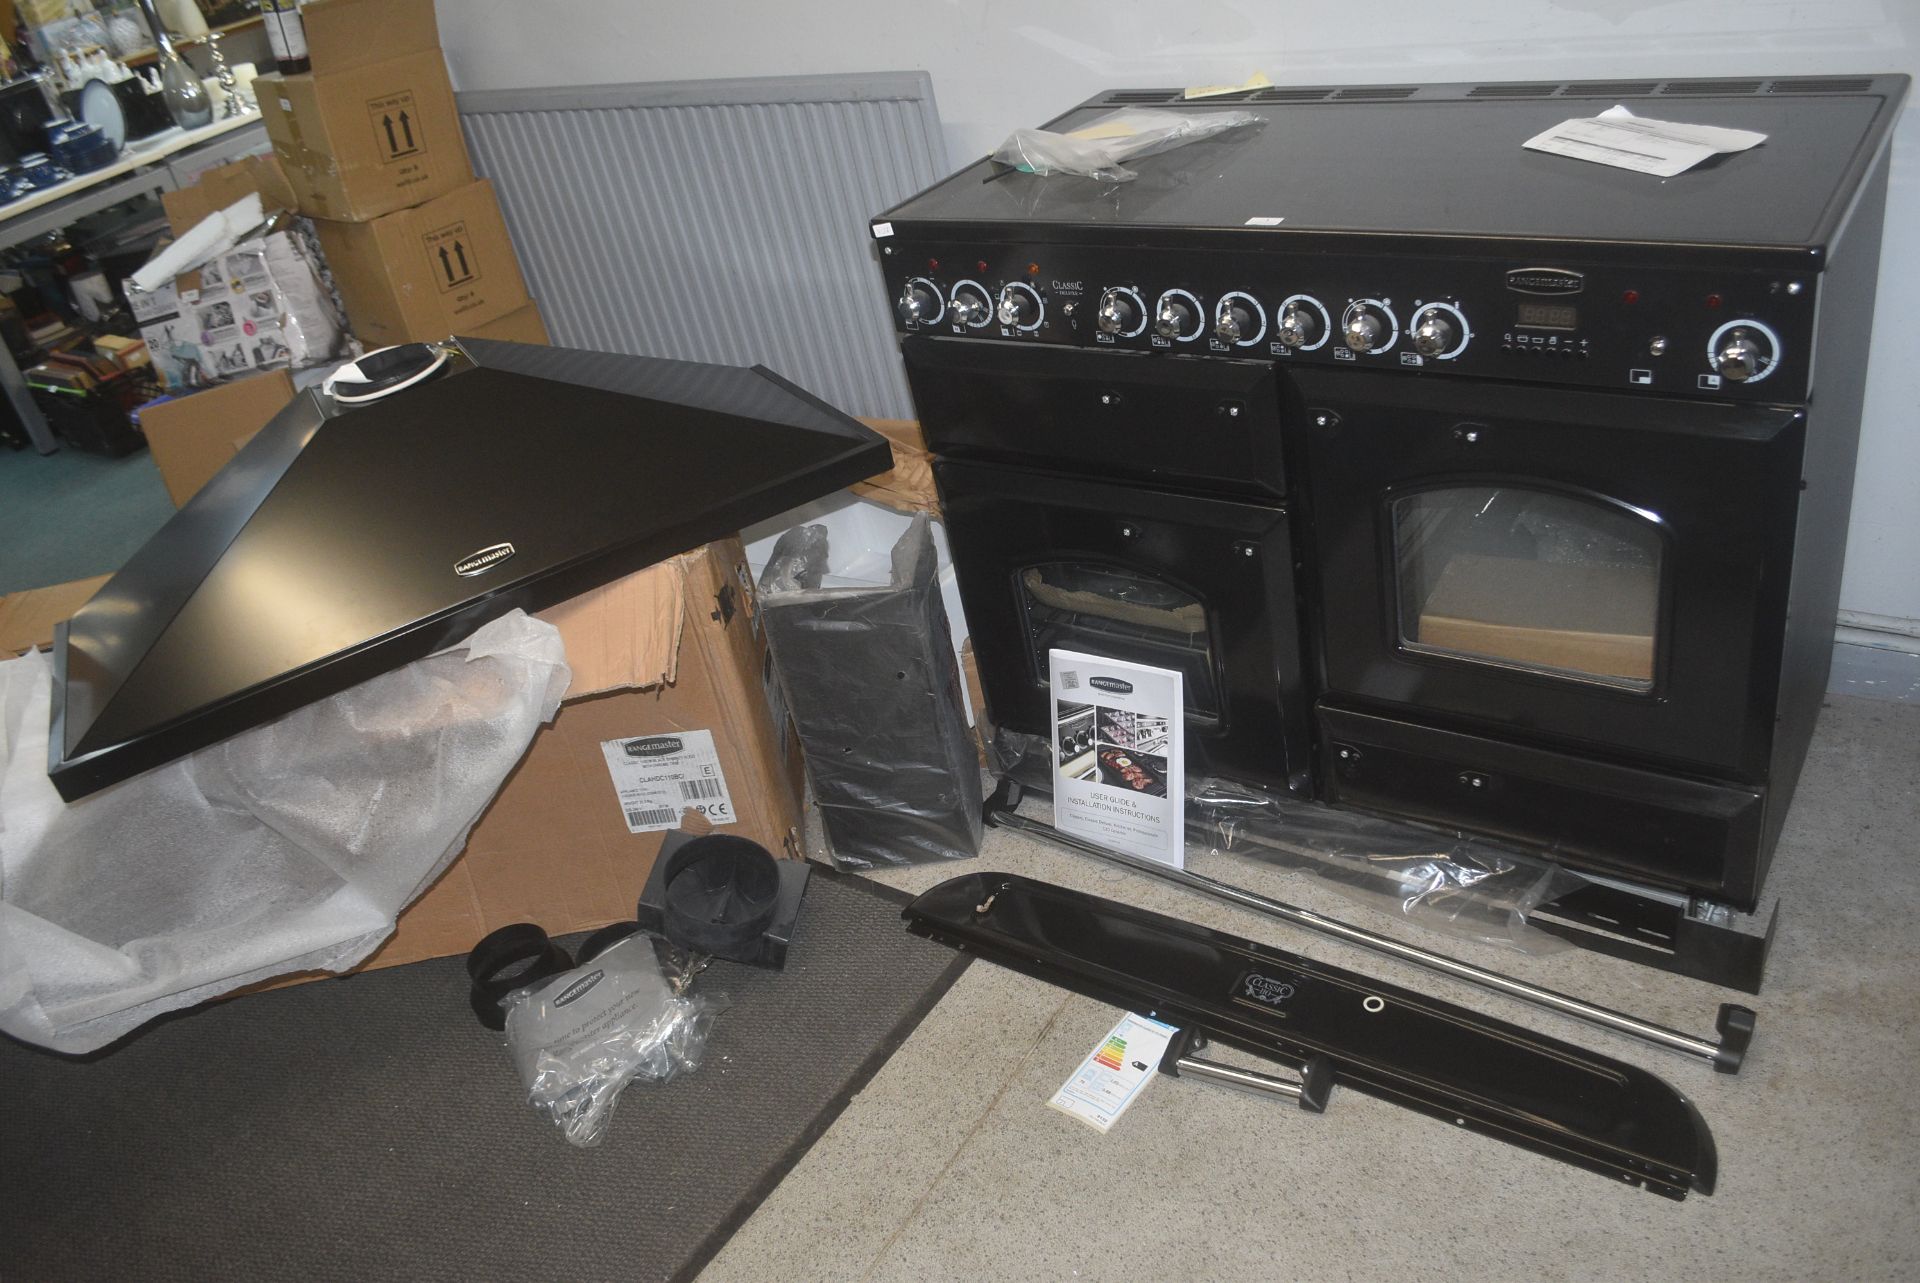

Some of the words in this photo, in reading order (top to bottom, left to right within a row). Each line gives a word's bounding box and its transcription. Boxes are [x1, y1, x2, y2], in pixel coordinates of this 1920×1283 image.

[1053, 280, 1083, 290] CLASSIC
[703, 766, 712, 776] E
[1090, 792, 1109, 801] USER
[1110, 796, 1130, 807] GUIDE
[1067, 797, 1112, 813] INSTALLATION
[1112, 806, 1161, 824] INSTRUCTIONS
[554, 971, 603, 1006] RANGEmaster
[1252, 977, 1288, 995] CLASSIC
[572, 1026, 581, 1035] to
[581, 1008, 608, 1033] protect
[608, 998, 624, 1016] your
